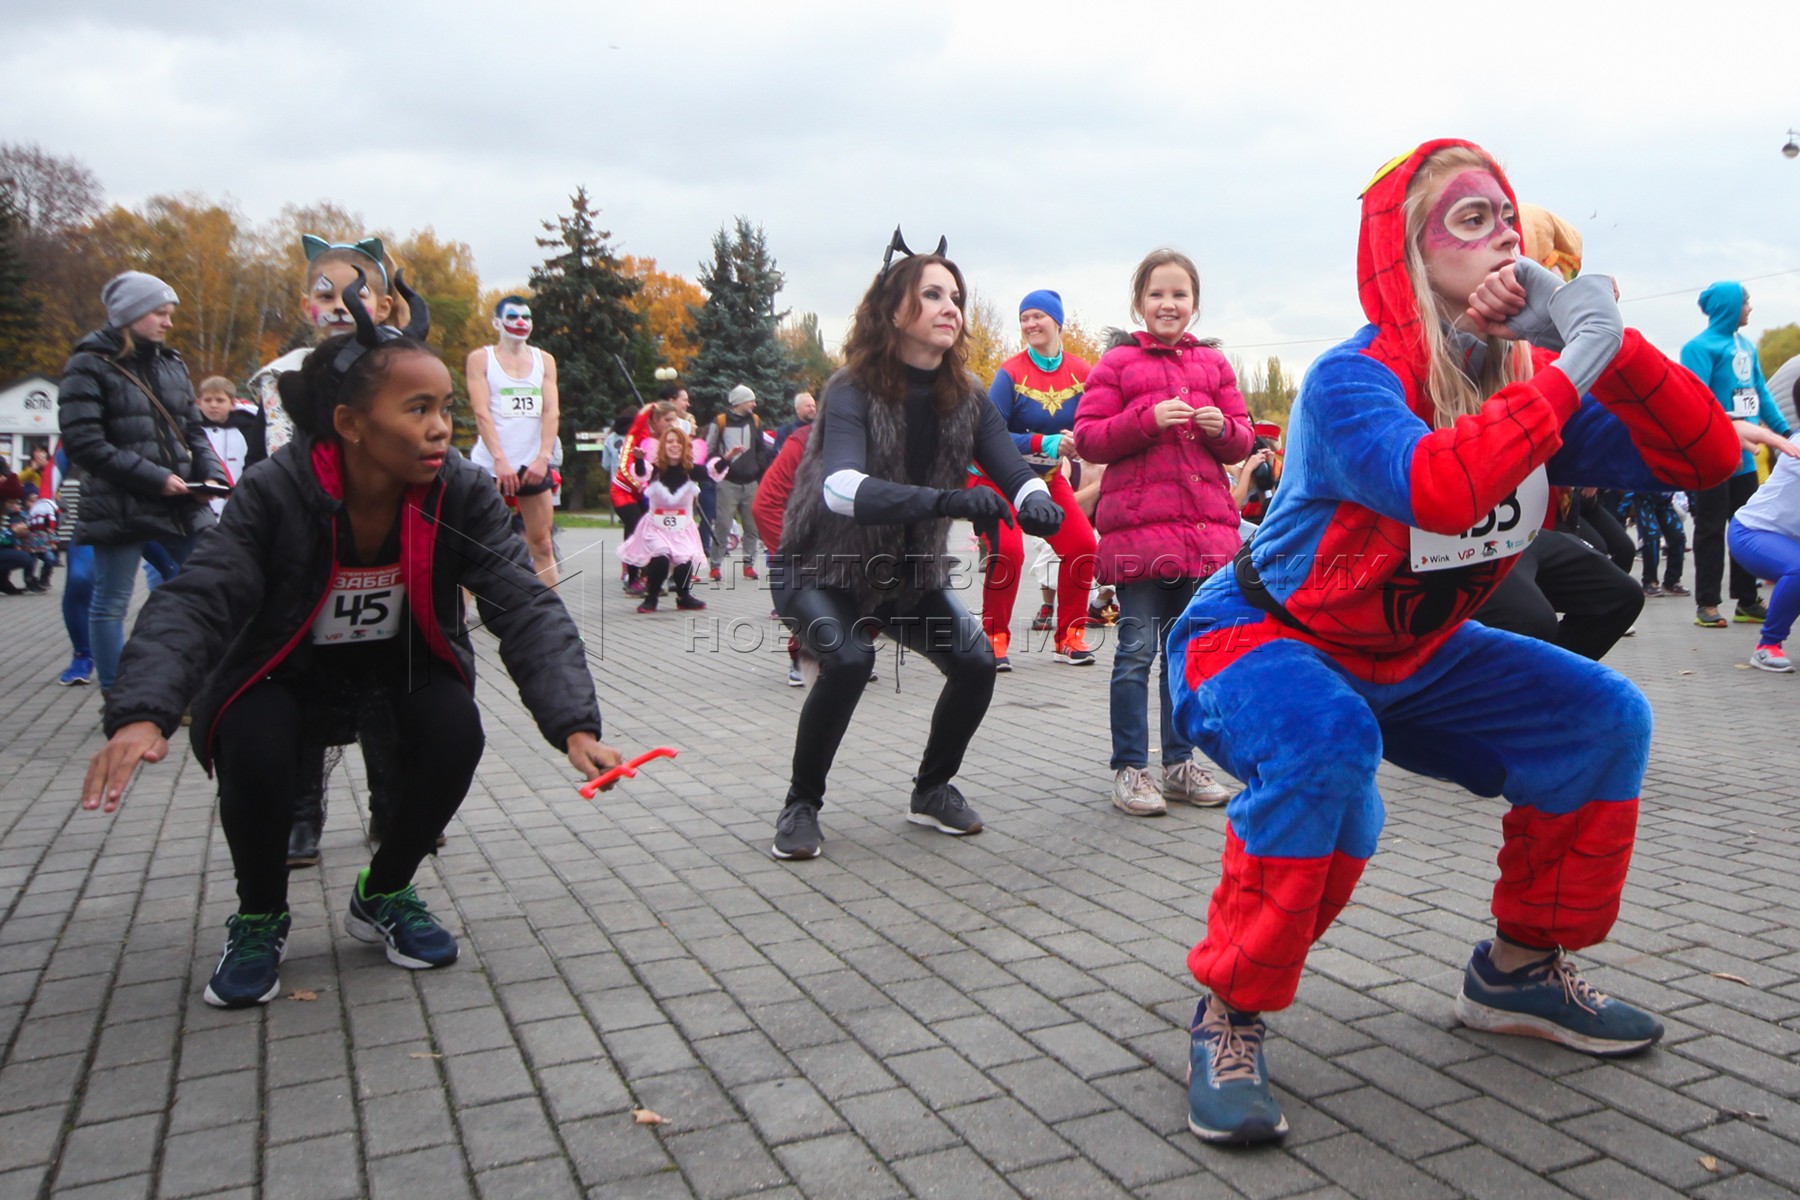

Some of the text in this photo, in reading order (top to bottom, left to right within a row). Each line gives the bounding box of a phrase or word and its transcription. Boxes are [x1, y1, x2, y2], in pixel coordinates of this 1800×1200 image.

[511, 396, 534, 411] 213
[663, 516, 677, 527] 63
[1429, 554, 1451, 564] Wink
[334, 572, 401, 589] ЗАБЕГ
[334, 590, 392, 627] 45
